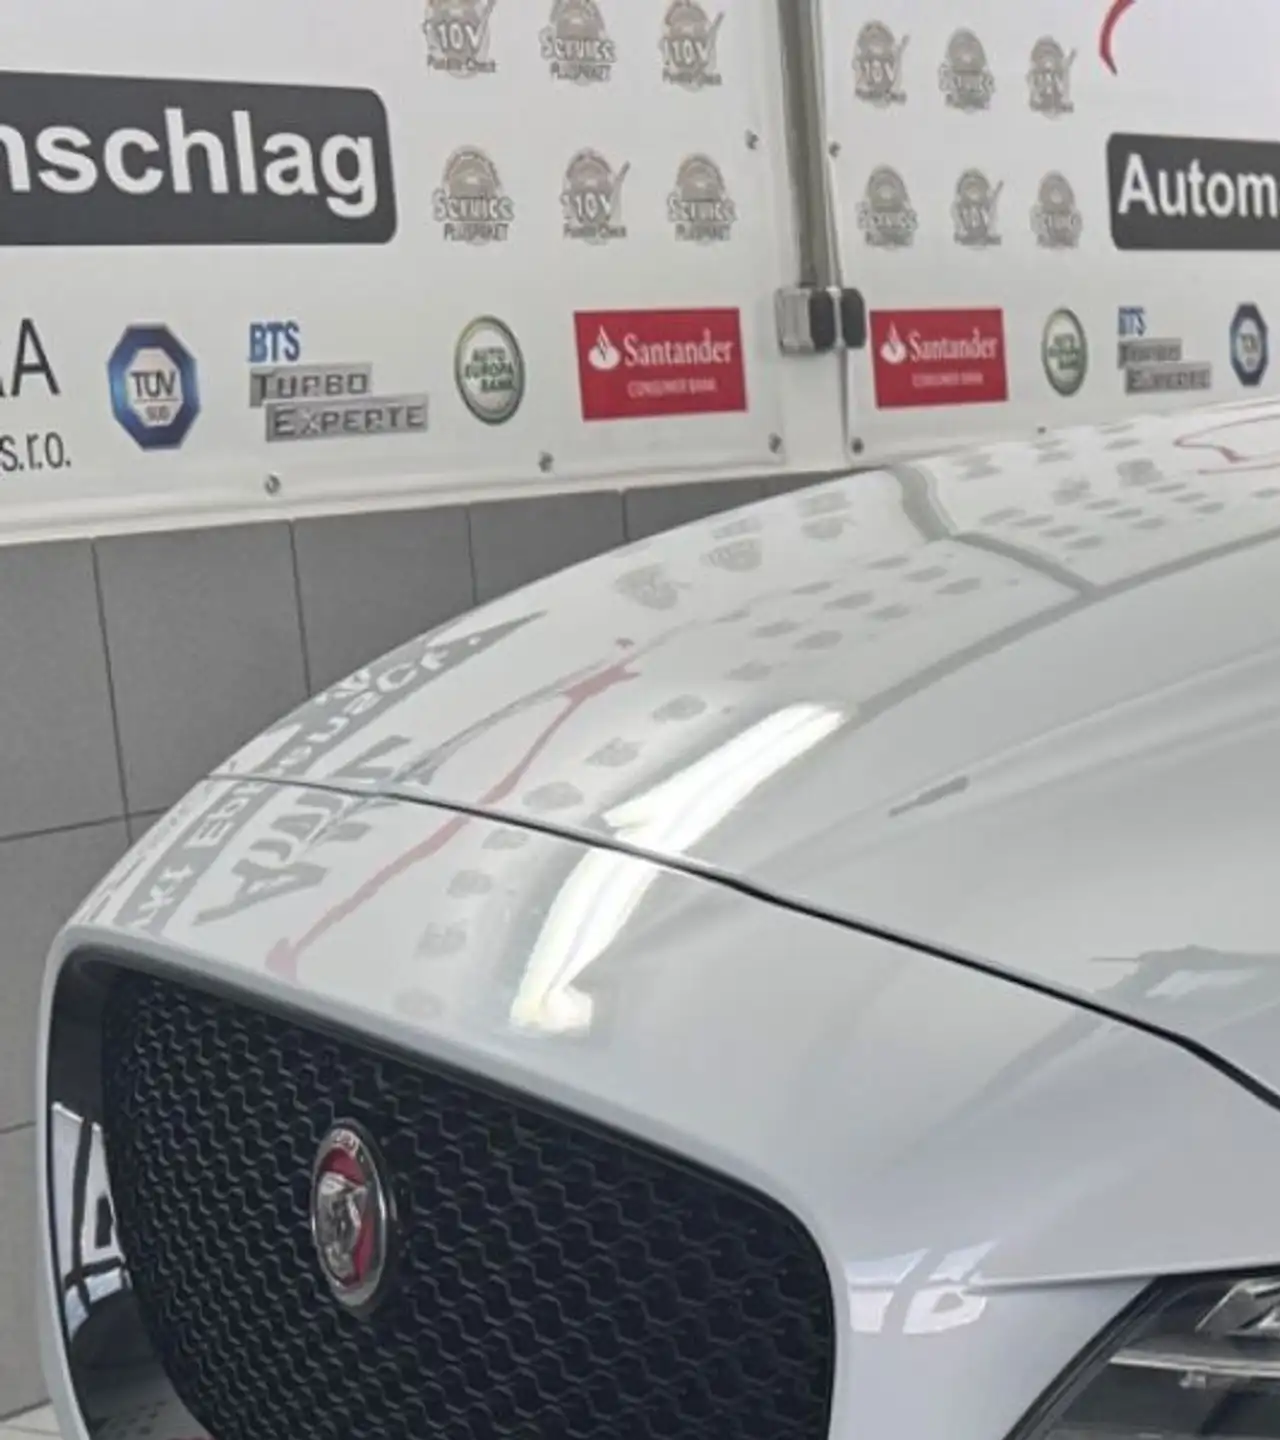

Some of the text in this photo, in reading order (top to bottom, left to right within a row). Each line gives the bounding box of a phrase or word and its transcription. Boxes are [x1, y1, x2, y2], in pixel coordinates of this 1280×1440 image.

[249, 321, 300, 363] BTS
[623, 327, 734, 368] Santander
[908, 326, 998, 363] Santander
